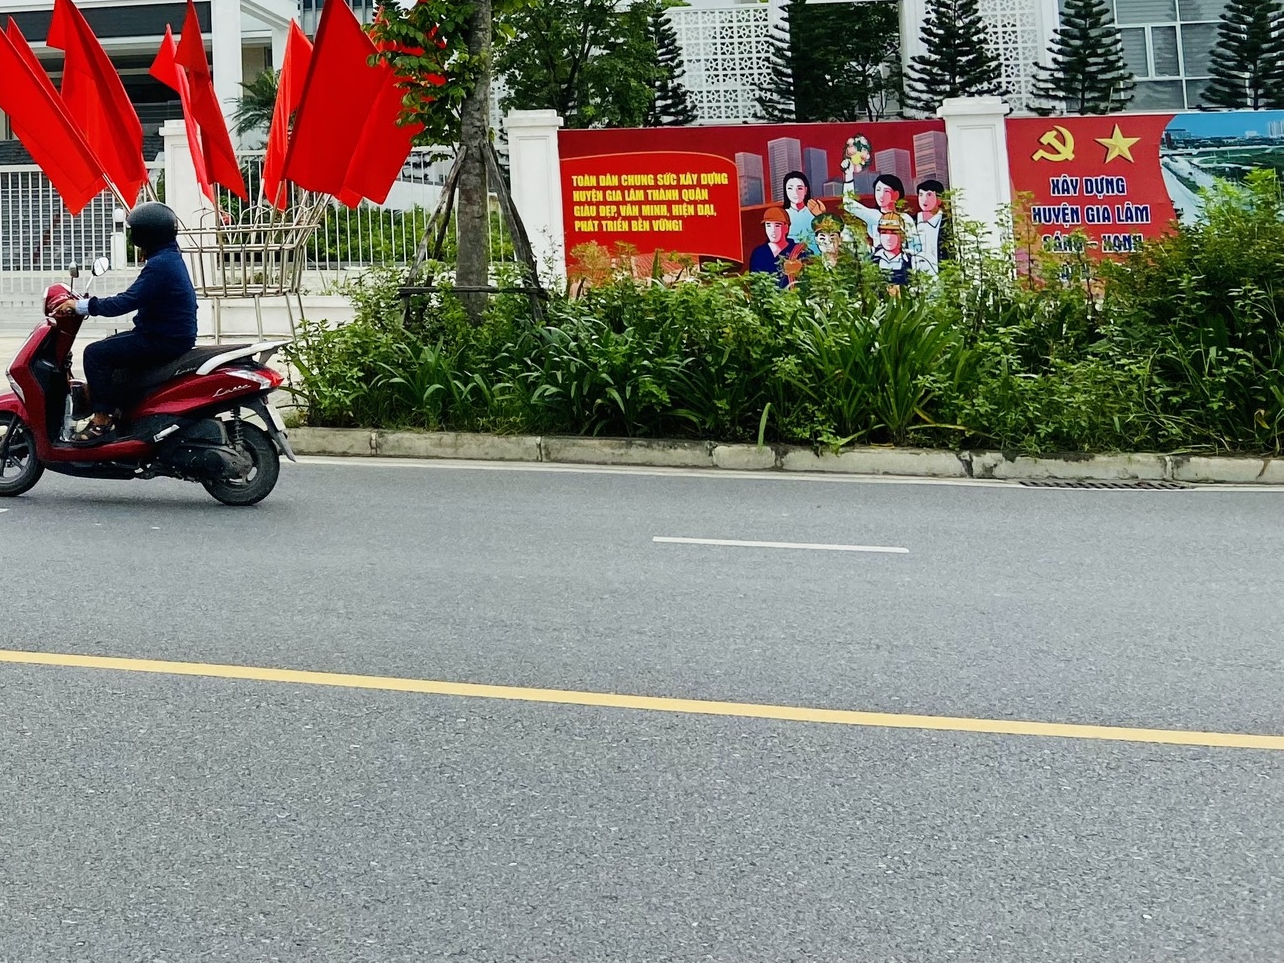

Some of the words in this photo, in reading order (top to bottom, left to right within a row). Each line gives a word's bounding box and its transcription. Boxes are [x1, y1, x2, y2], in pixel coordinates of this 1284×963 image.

[571, 173, 597, 187] TOÀN
[598, 172, 619, 187] DÂN
[621, 173, 655, 187] CHUNG
[657, 172, 677, 186] SỨC
[679, 171, 699, 186] XÂY
[700, 171, 729, 187] DỰNG
[1050, 174, 1080, 197] XÂY
[1082, 175, 1127, 199] DỰNG
[572, 188, 604, 204] HUYỆN
[605, 189, 623, 202] GIA
[624, 188, 645, 201] LÂM
[646, 187, 680, 201] THÀNH
[681, 187, 709, 203] QUẬN
[573, 203, 597, 217] GIÀU
[598, 205, 618, 219] ĐẸP,
[619, 203, 640, 217] VĂN
[641, 203, 670, 217] MINH,
[671, 202, 695, 218] HIỆN
[696, 203, 717, 218] ĐẠI,
[1031, 202, 1082, 228] HUYỆN
[1084, 205, 1113, 225] GIA
[1115, 201, 1151, 224] LÂM
[574, 218, 600, 232] PHÁT
[601, 216, 630, 232] TRIỂN
[631, 216, 650, 232] BỀN
[652, 217, 683, 232] VỮNG!
